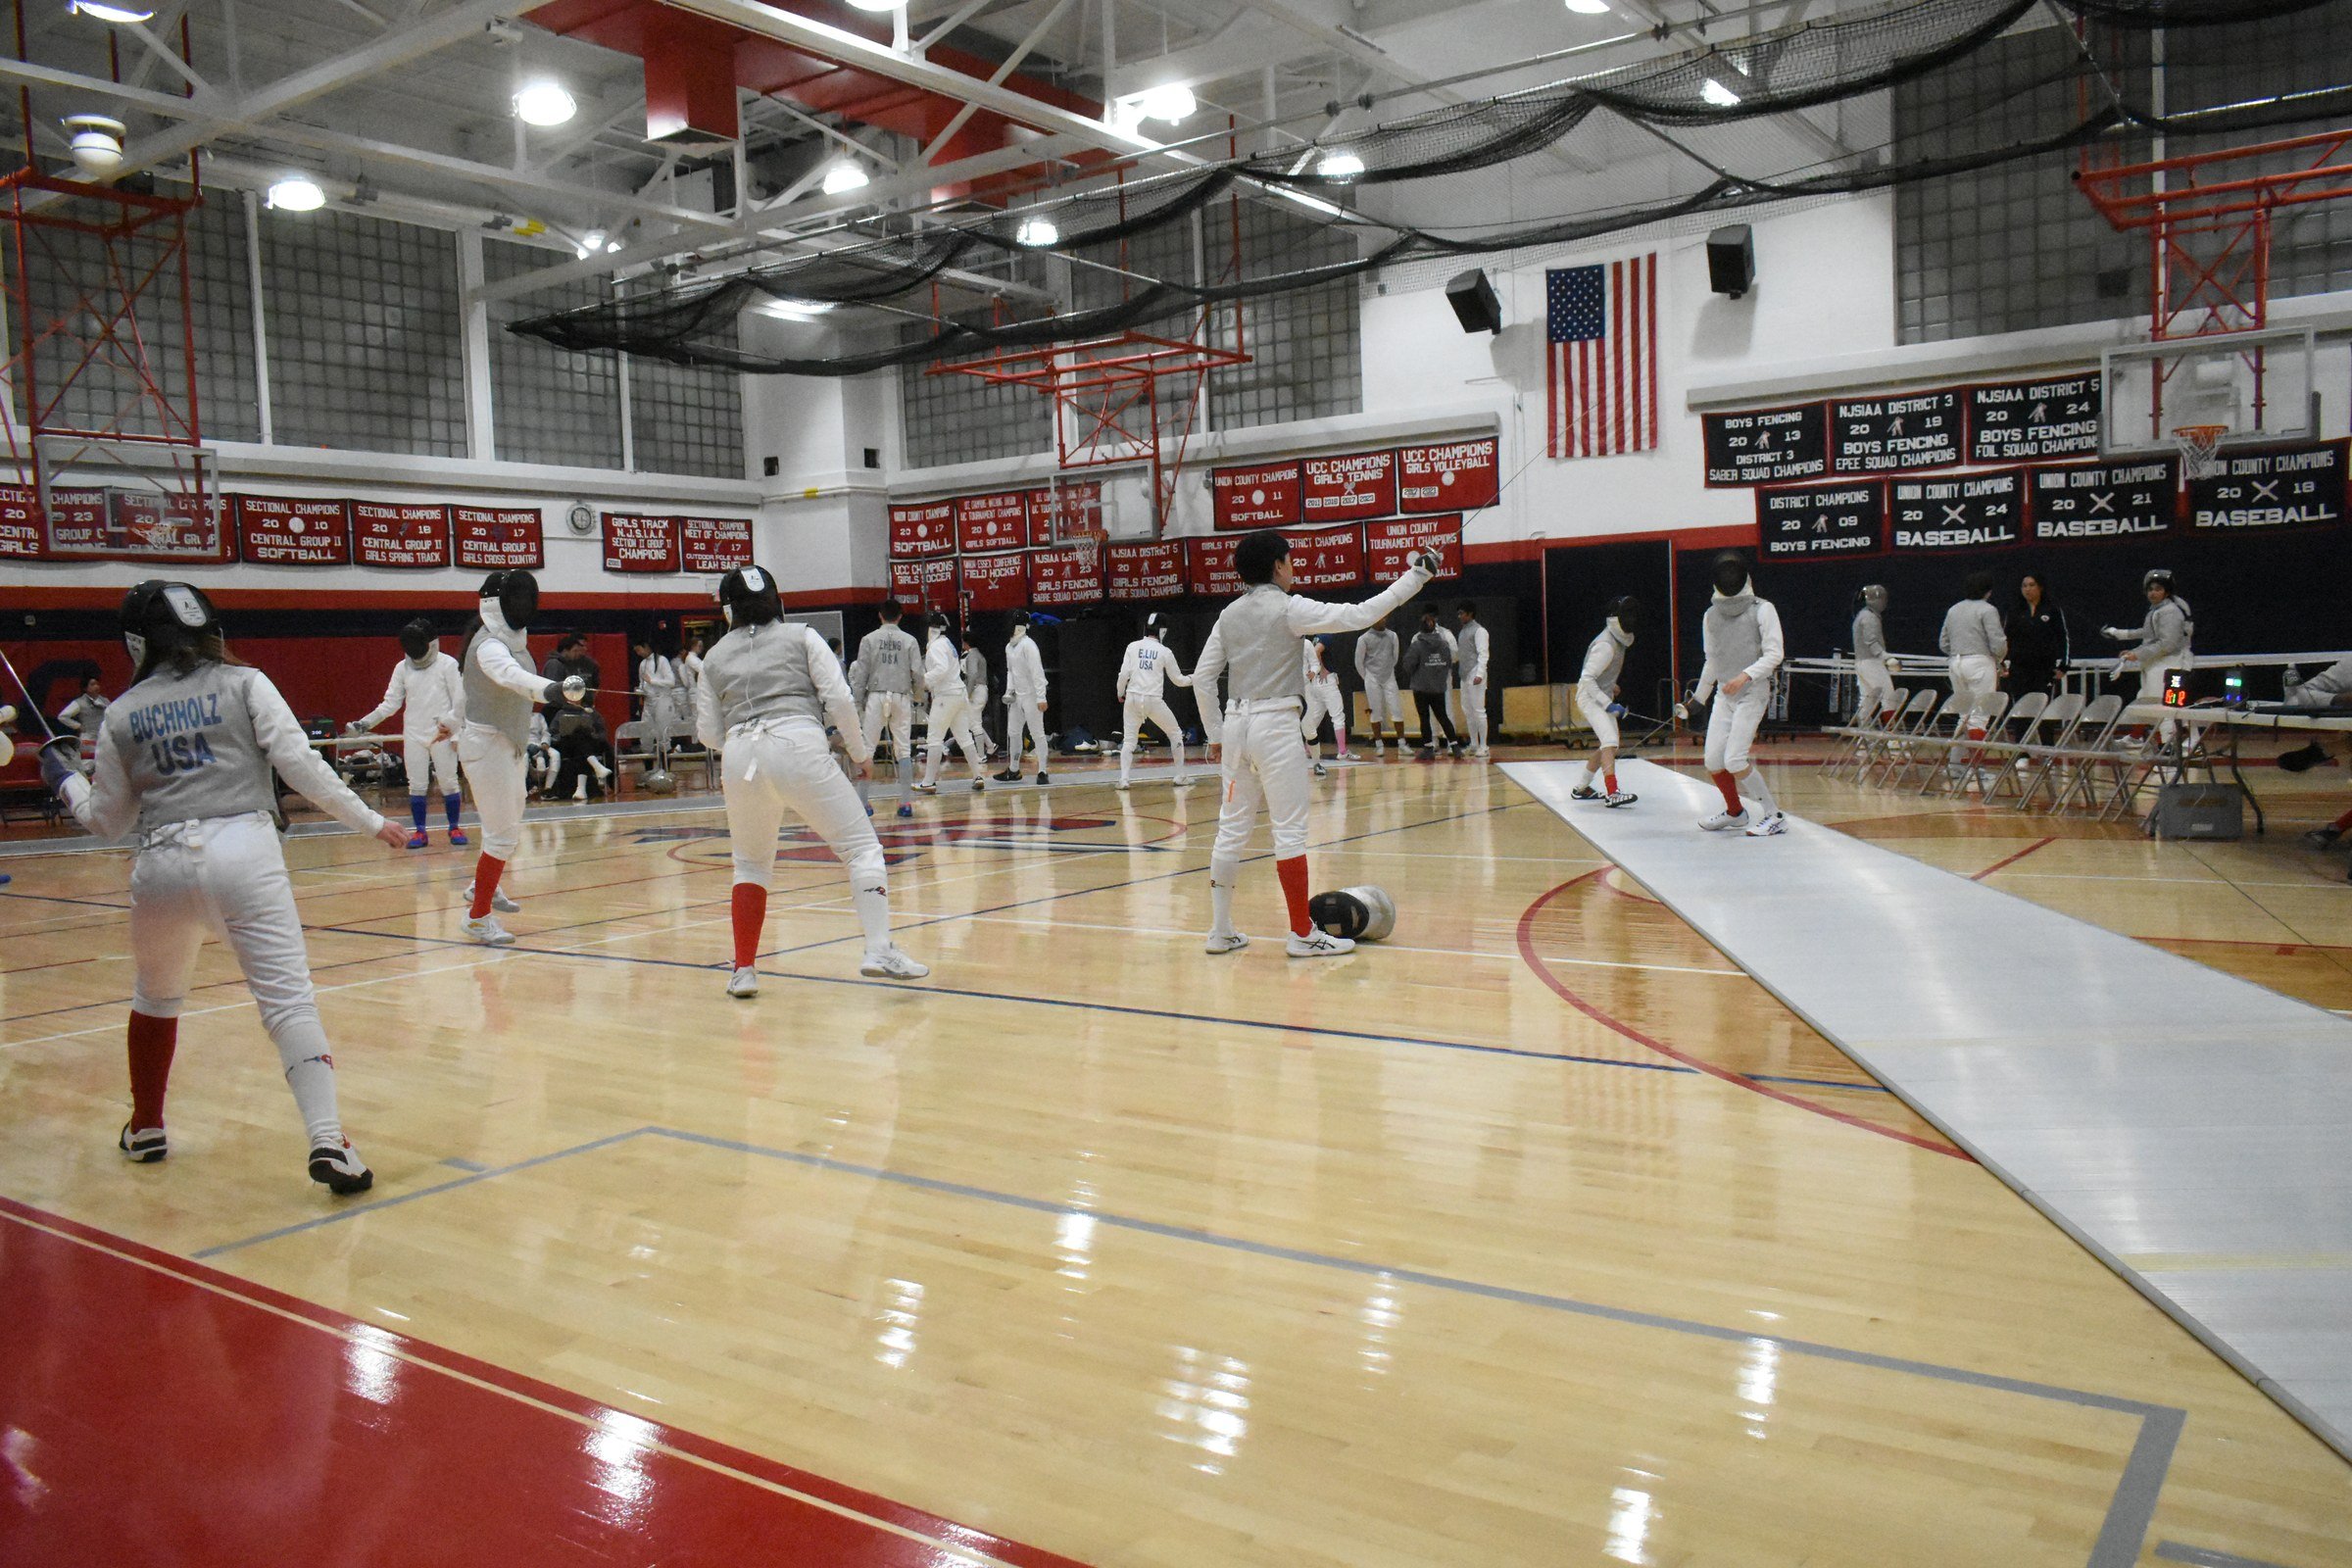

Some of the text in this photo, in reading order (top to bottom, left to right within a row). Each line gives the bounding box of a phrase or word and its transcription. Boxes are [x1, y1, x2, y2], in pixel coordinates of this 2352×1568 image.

[1977, 378, 2100, 403] NJSIAA DISTRICT 5
[1839, 395, 1953, 417] NJSIAA DISTRICT 3
[1986, 402, 2090, 421] 20 24
[1725, 412, 1802, 428] BOYS FENCING
[1849, 424, 1870, 434] 20
[1980, 419, 2097, 442] BOYS FENCING
[1729, 430, 1801, 447] 20 13
[1843, 433, 1948, 454] BOYS FENCING
[1403, 442, 1493, 463] UCC CHAMPIONS
[1976, 445, 1999, 457] FOIL
[2003, 442, 2037, 457] SQUAD
[1306, 454, 1391, 474] UCC CHAMPIONS
[1406, 456, 1490, 473] GIRLS VOLLEYBALL
[1736, 450, 1794, 465] DISTRICT 3
[1836, 448, 1956, 469] EPEE SQUAD CHAMPIONS
[2232, 458, 2271, 475] COUNTY
[2276, 450, 2334, 472] CHAMPIONS
[1261, 468, 1298, 483] CHAMPIONS
[1314, 469, 1383, 484] GIRLS TENNIS
[1741, 466, 1770, 479] SQUAD
[1774, 460, 1824, 477] CHAMPIONS
[2070, 470, 2107, 488] COUNTY
[2112, 464, 2166, 484] CHAMPIONS
[1926, 483, 1960, 499] COUNTY
[1964, 477, 2013, 497] CHAMPIONS
[2217, 487, 2241, 499] 20
[51, 493, 103, 505] CHAMPIONS
[1232, 495, 1246, 504] 20
[1770, 490, 1869, 509] DISTRICT CHAMPIONS
[2052, 493, 2152, 510] 20 21
[246, 501, 340, 515] SECTIONAL CHAMPIONS
[358, 506, 441, 519] SECTIONAL CHAMPIONS
[1902, 504, 2008, 520] 20 24
[2195, 503, 2337, 527] BASEBALL
[5, 509, 93, 522] 20 23
[459, 511, 534, 523] SECTIONAL CHAMPIONS
[612, 517, 668, 528] GIRLS TRACK
[1230, 510, 1283, 521] SOFTBALL
[1782, 515, 1858, 530] 20 09
[262, 518, 328, 530] 20 10
[372, 523, 388, 533] 20
[971, 522, 1012, 534] 20 12
[1387, 521, 1438, 536] UNION COUNTY
[2037, 514, 2168, 536] BASEBALL
[56, 529, 92, 540] GROUP
[471, 527, 525, 537] 20 17
[1896, 525, 2015, 546] BASEBALL
[251, 533, 296, 546] CENTRAL
[300, 536, 331, 547] GROUP
[363, 537, 402, 549] CENTRAL
[405, 540, 432, 550] GROUP
[463, 540, 499, 552] CENTRAL
[502, 542, 526, 552] GROUP
[894, 537, 952, 553] SOFTBALL
[1314, 533, 1352, 548] CHAMPIONS
[1370, 532, 1457, 549] TOURNAMENT CHAMPIONS
[1771, 536, 1871, 552] BOYS FENCING
[257, 548, 336, 560] SOFTBALL
[366, 550, 386, 562] GIRLS
[416, 553, 441, 563] TRACK
[463, 552, 482, 564] GIRLS
[508, 554, 537, 564] COUNTRY
[618, 548, 666, 560] CHAMPIONS
[1140, 546, 1170, 558] DISTRICT
[697, 561, 718, 569] LEAH
[1293, 558, 1307, 566] 20
[1385, 556, 1399, 564] 20
[894, 564, 909, 575] UCC
[965, 565, 1020, 578] FIELD HOCKEY
[1117, 564, 1129, 572] 20
[898, 575, 919, 584] GIRLS
[1113, 573, 1178, 587] GIRLS FENCING
[1314, 571, 1356, 584] FENCING
[1375, 571, 1398, 580] GIRLS
[1037, 578, 1098, 591] GIRLS FENCING
[882, 653, 899, 665] USA
[1139, 660, 1153, 671] USA
[129, 693, 222, 744] BUCHHOLZ
[151, 732, 217, 775] USA
